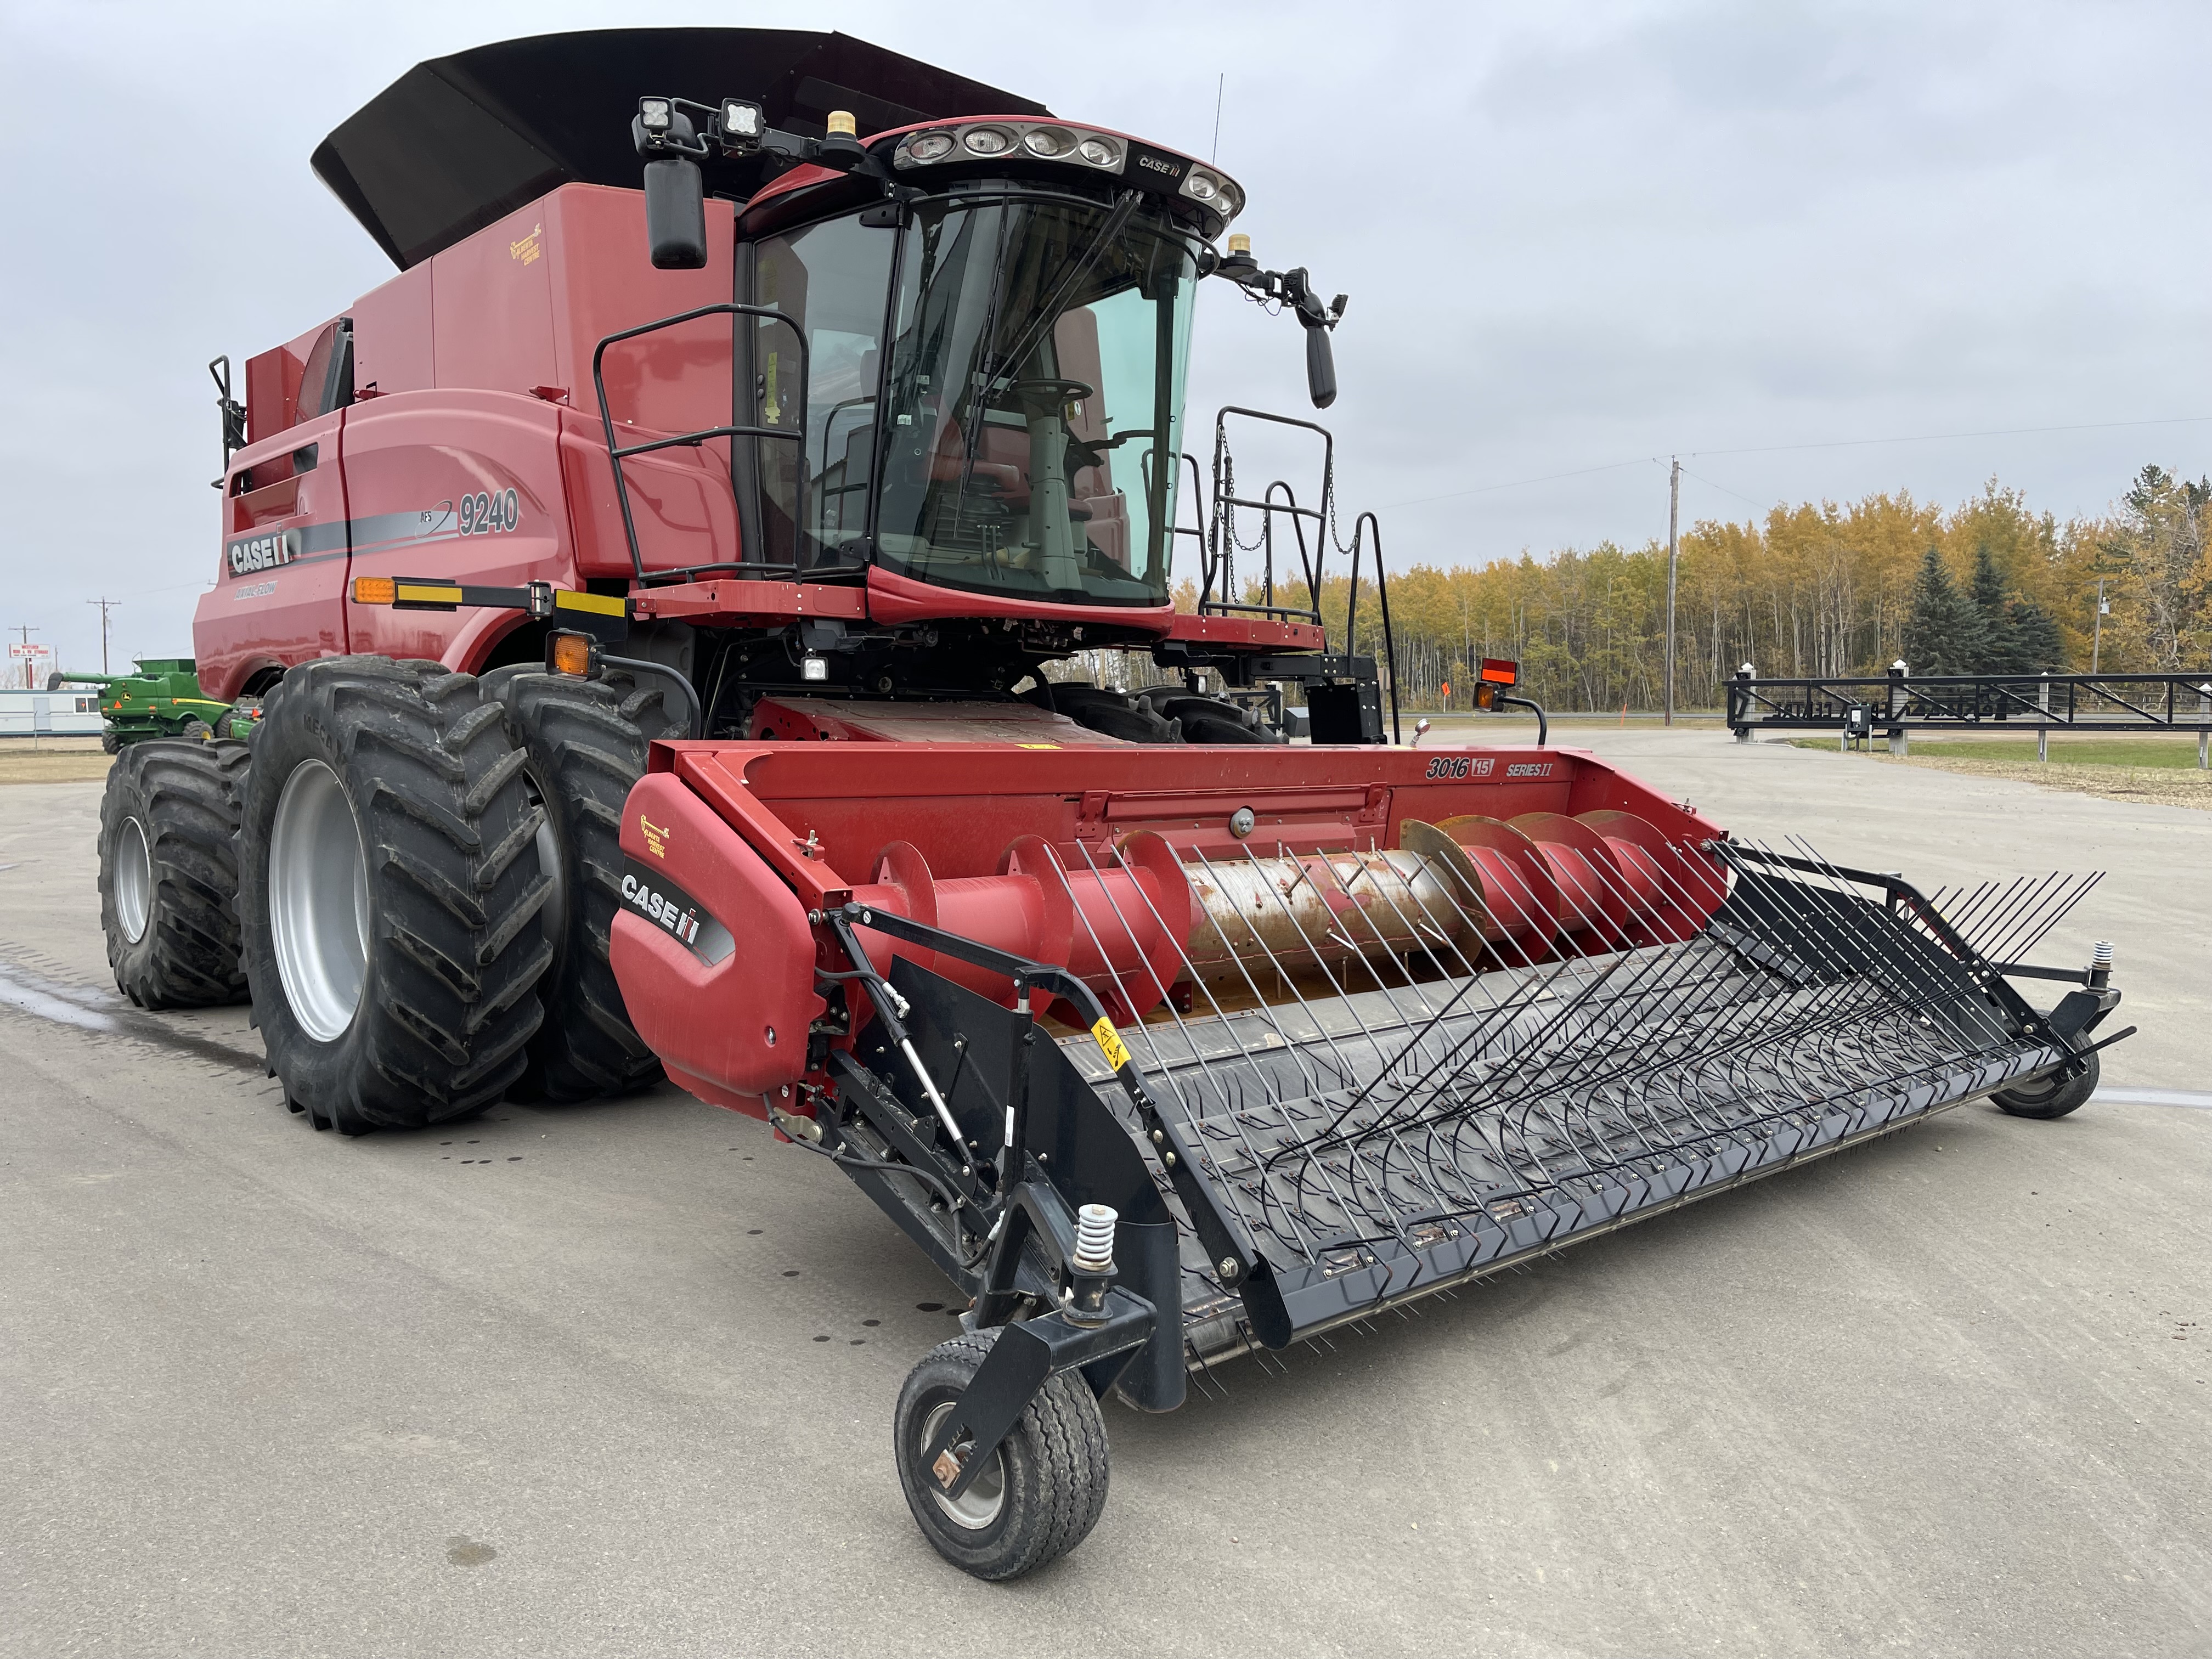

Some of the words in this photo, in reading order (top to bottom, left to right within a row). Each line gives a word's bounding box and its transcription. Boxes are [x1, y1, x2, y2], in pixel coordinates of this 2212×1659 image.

[1139, 157, 1170, 174] CASE
[420, 511, 432, 523] AFS
[460, 487, 519, 537] 9240
[232, 538, 274, 573] CASE
[234, 580, 278, 601] AXIAL-FLOW
[1426, 757, 1470, 780] 3016
[1476, 761, 1489, 774] 15
[1506, 764, 1541, 777] SERIES
[1540, 763, 1553, 776] II
[644, 829, 660, 843] ALBERTA
[647, 837, 665, 852] HARVEST
[649, 845, 665, 859] CENTRE
[622, 874, 680, 931] CASE
